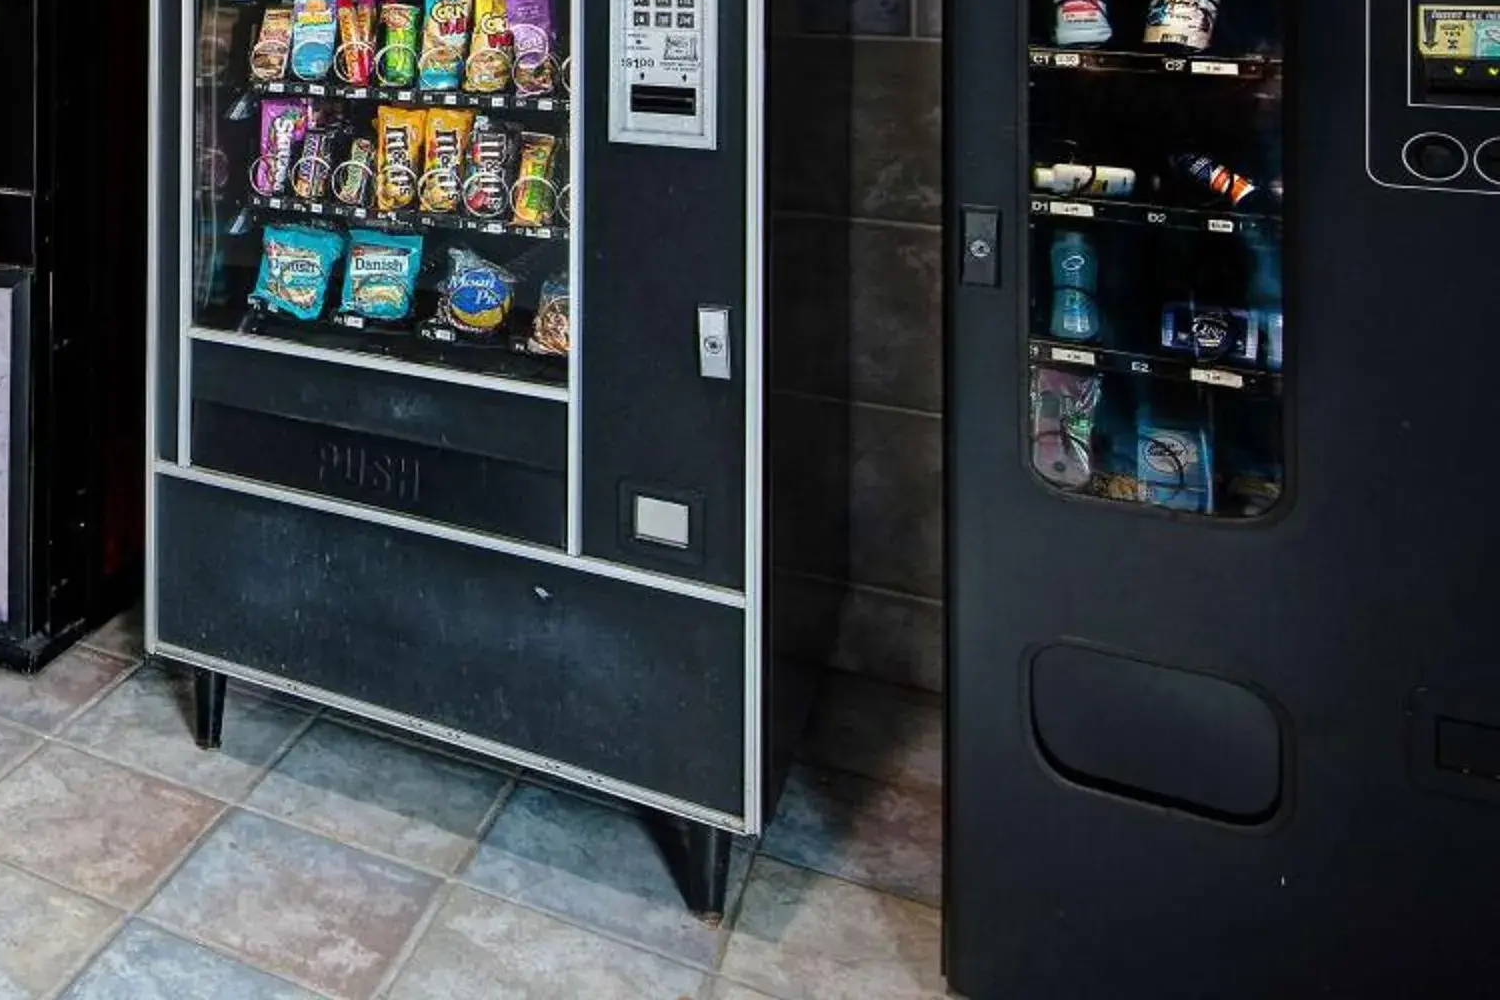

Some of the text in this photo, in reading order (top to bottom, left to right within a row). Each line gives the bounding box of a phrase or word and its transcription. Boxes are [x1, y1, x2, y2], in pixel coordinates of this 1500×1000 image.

[431, 0, 468, 23] CORN
[355, 258, 404, 273] Danish
[319, 443, 420, 502] PUSH
